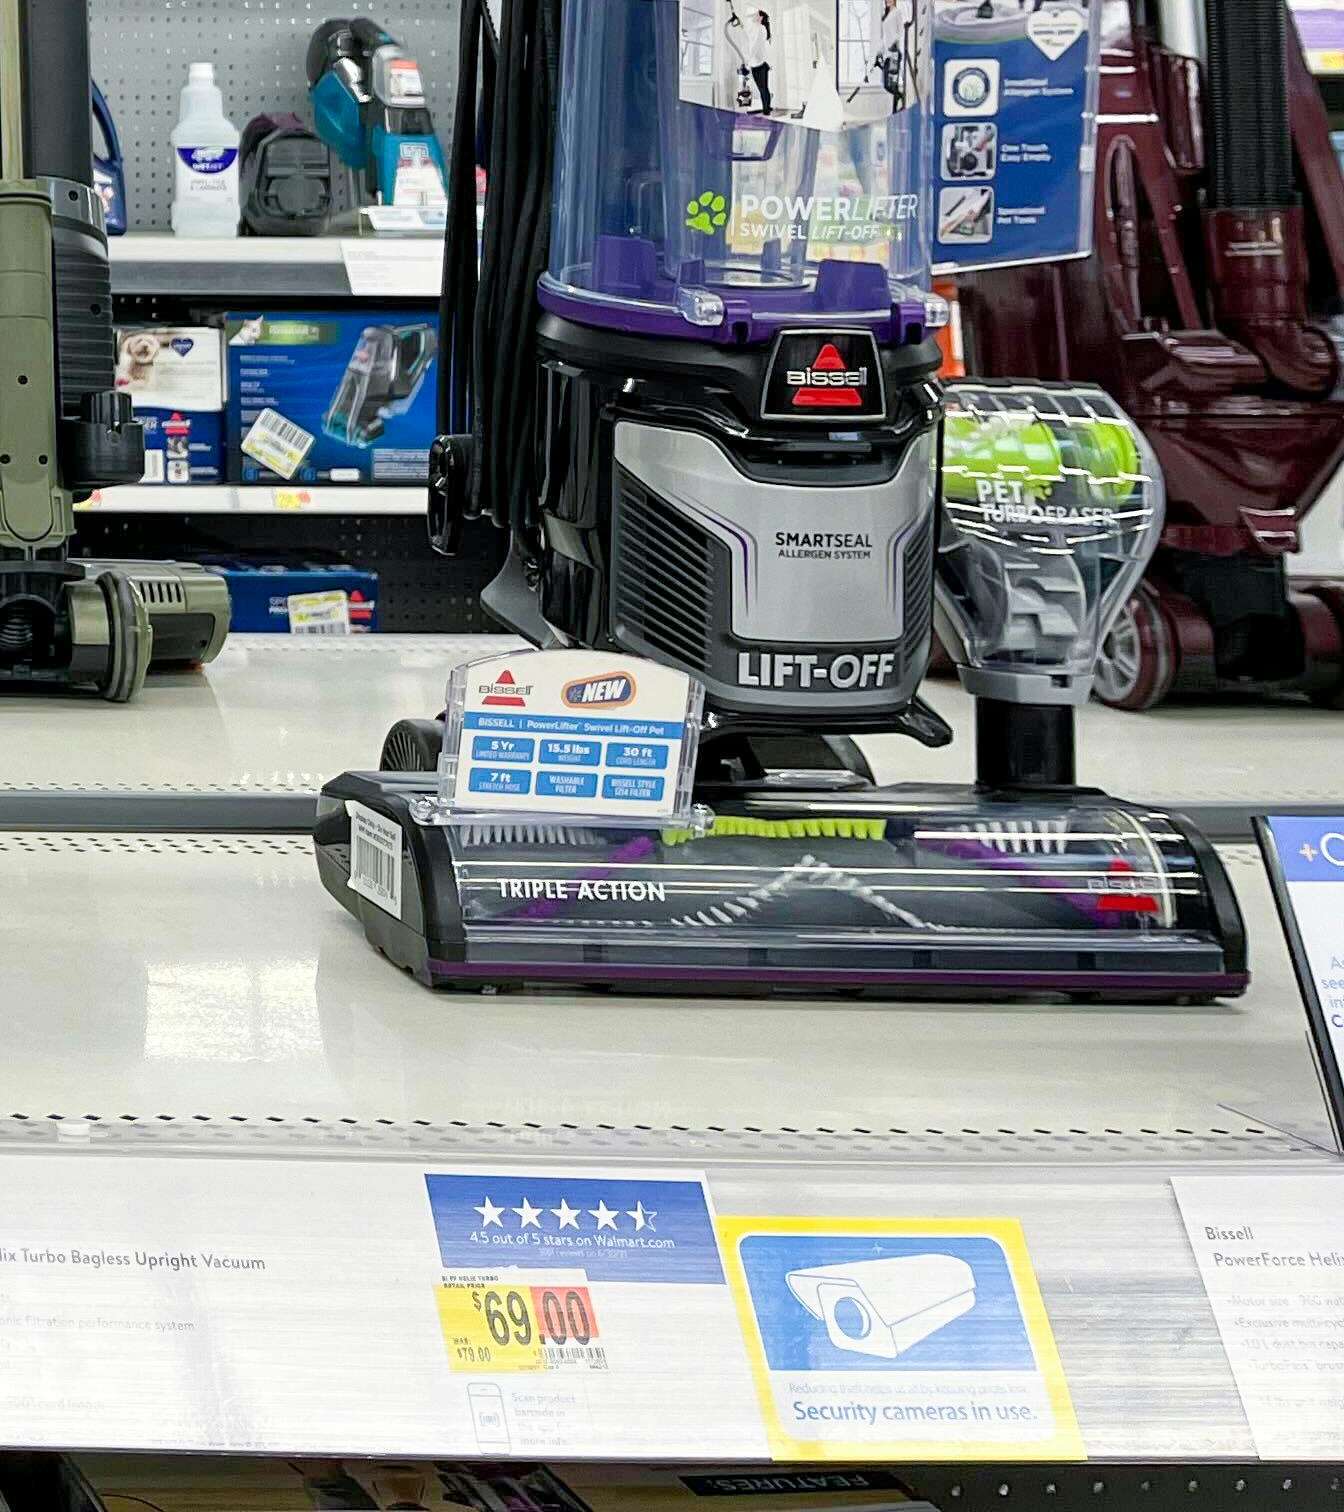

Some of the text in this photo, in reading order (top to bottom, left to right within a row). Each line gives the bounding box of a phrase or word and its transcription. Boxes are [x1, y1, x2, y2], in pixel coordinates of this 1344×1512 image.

[740, 193, 919, 222] POWERLIFTER
[739, 223, 881, 240] SWIVEL LIFT-OFF
[977, 479, 1023, 505] PET
[775, 531, 874, 549] SMARTSEAL
[778, 549, 872, 560] ALLERGEN SYSTEM
[737, 652, 896, 688] LIFT-OFF
[581, 678, 628, 703] NEW
[478, 717, 515, 729] BISSELL
[497, 878, 667, 902] TRIPLE ACTION
[469, 1231, 677, 1250] 4.5 out of 5 stars on Walmart.com
[1205, 1226, 1255, 1241] Bissell
[20, 1248, 67, 1264] Turbo
[70, 1249, 132, 1268] Bagless
[134, 1251, 198, 1271] Upright
[201, 1253, 267, 1271] Vacuum
[1212, 1251, 1307, 1268] PowerForce
[792, 1399, 1039, 1426] Security cameras in use.
